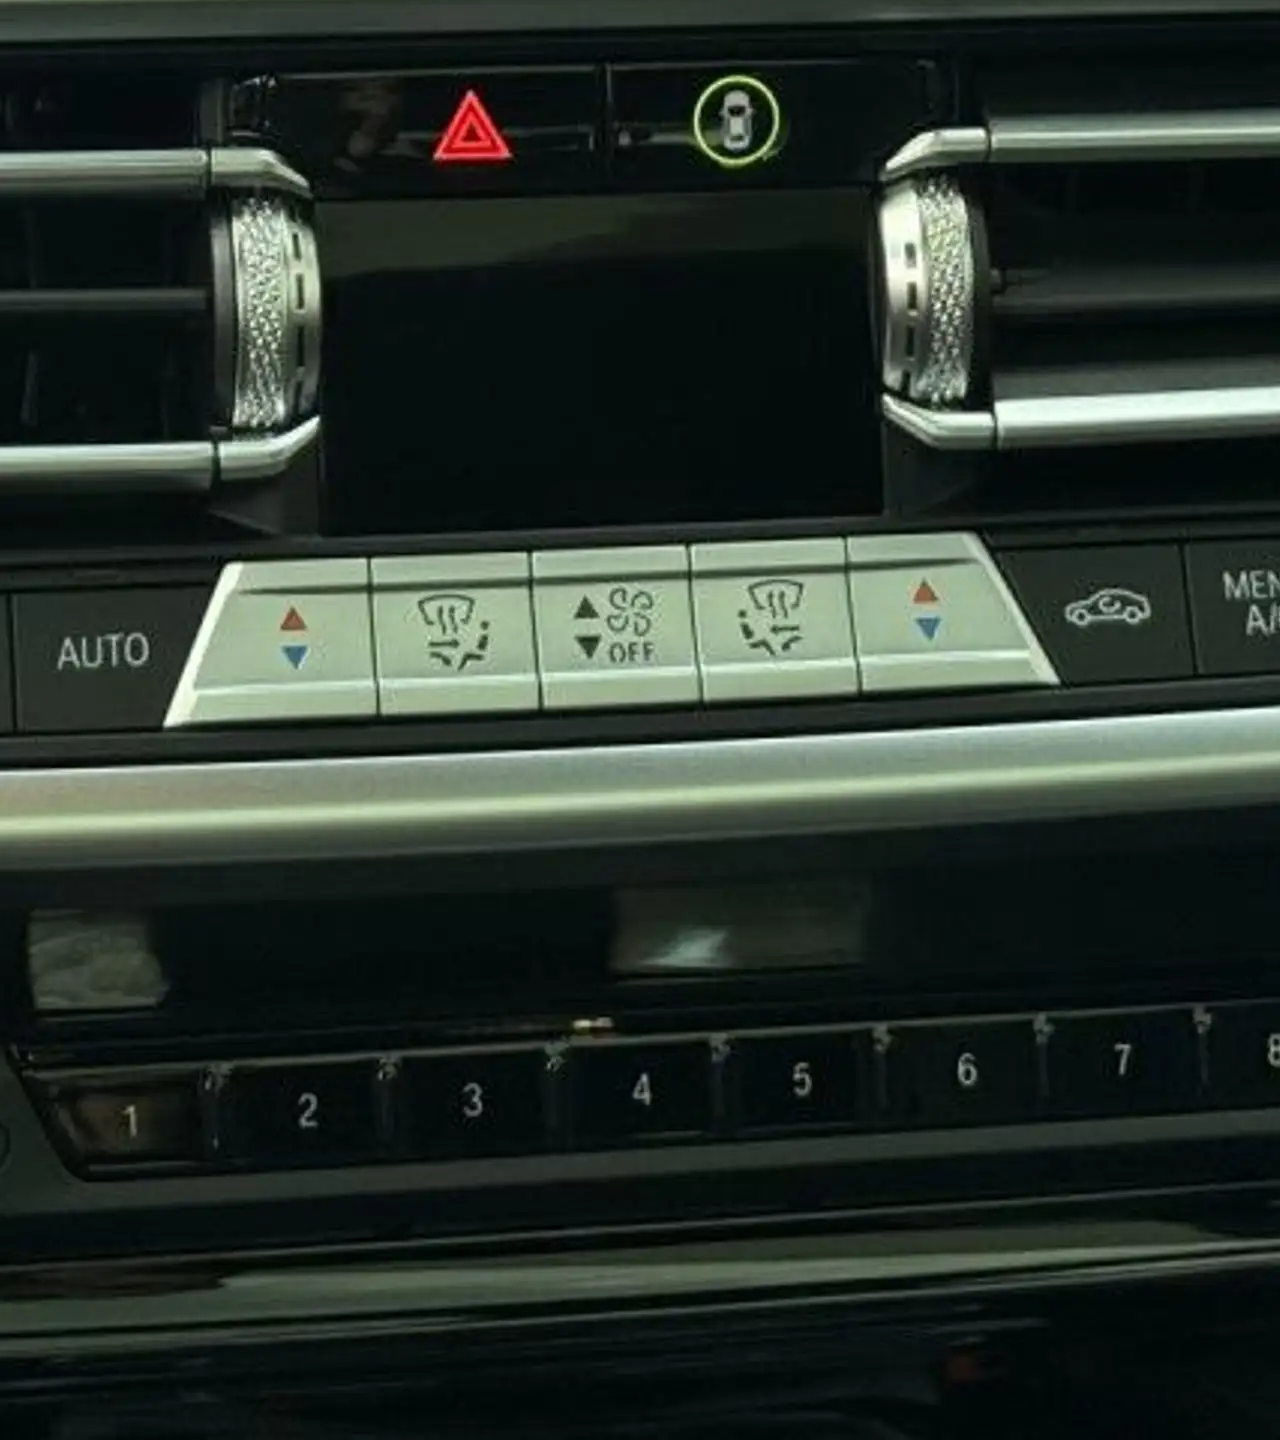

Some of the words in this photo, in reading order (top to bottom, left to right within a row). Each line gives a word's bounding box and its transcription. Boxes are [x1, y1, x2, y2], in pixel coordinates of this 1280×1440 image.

[56, 632, 150, 672] AUTO
[608, 643, 656, 664] OFF
[957, 1052, 977, 1086] 6
[1114, 1043, 1132, 1075] 7
[632, 1073, 652, 1105] 4
[793, 1063, 812, 1096] 5
[298, 1094, 318, 1128] 2
[463, 1083, 483, 1118] 3
[123, 1106, 138, 1139] 1
